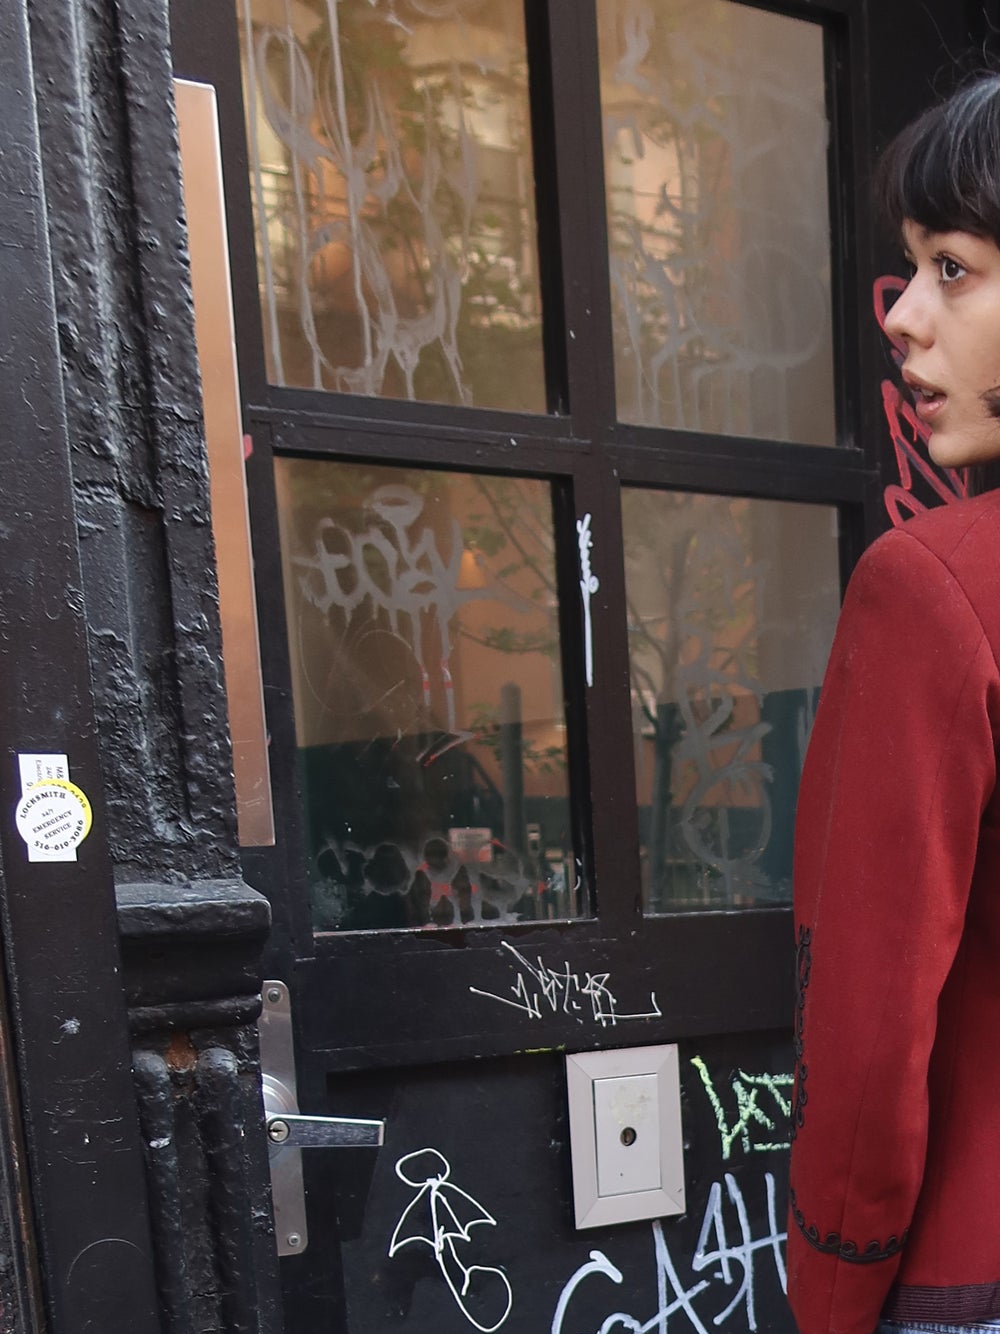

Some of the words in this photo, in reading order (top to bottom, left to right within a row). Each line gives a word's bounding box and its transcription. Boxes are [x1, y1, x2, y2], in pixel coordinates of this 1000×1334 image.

[20, 791, 66, 819] LOCKSMITH
[32, 810, 73, 834] EMERGENCY
[44, 822, 72, 839] SERVICE
